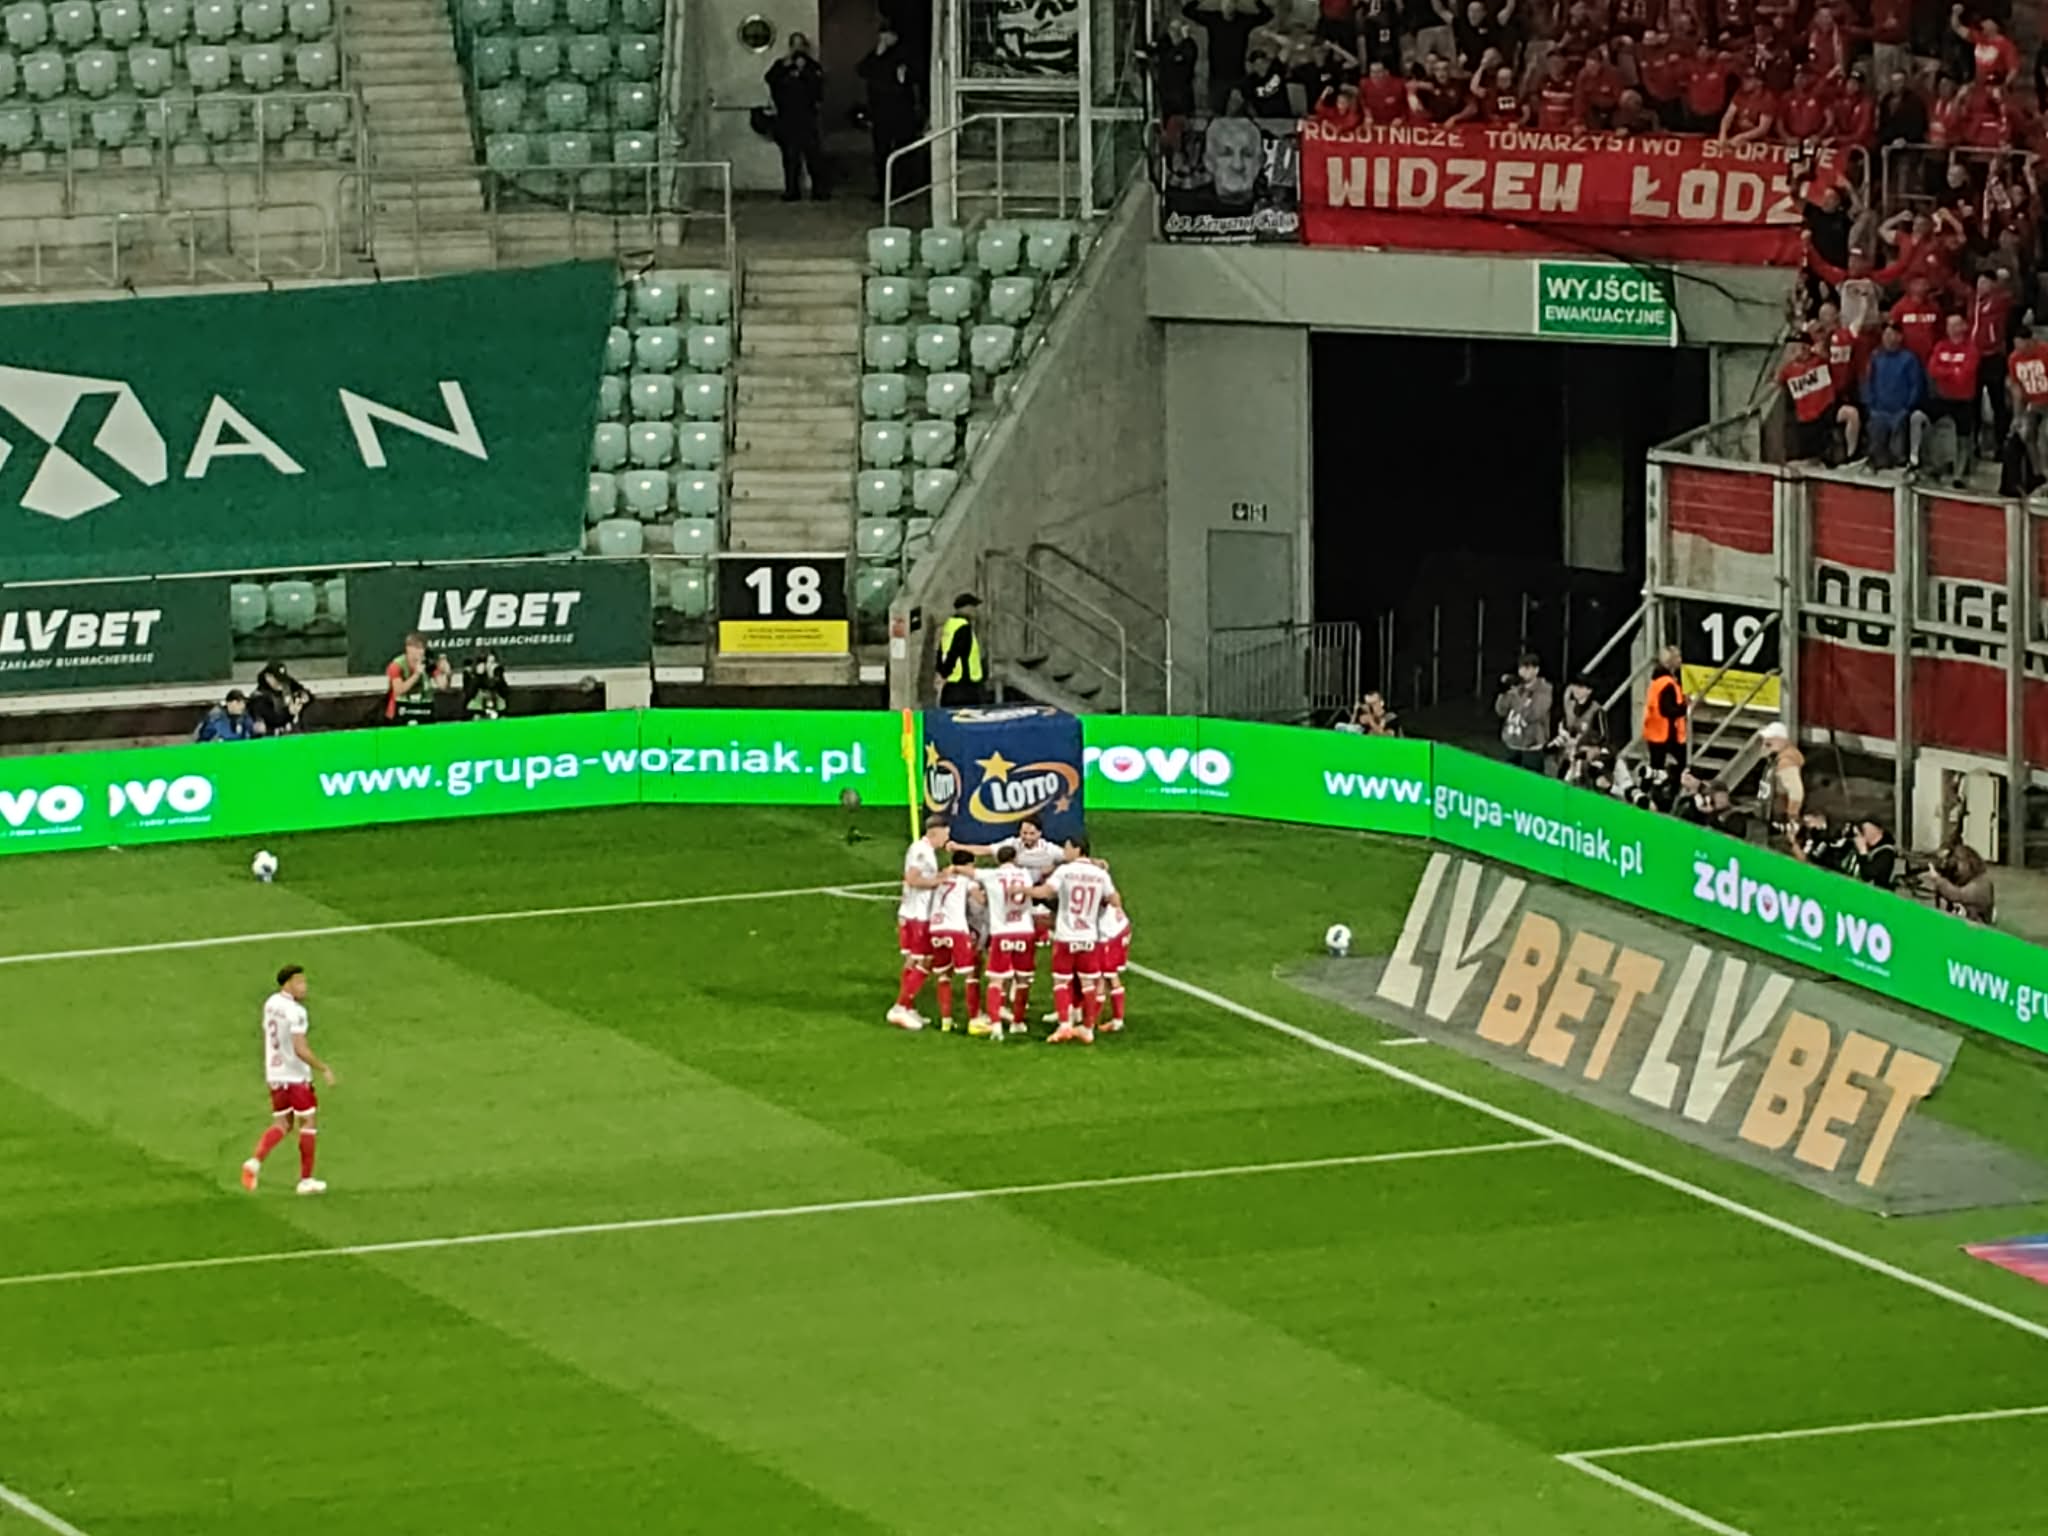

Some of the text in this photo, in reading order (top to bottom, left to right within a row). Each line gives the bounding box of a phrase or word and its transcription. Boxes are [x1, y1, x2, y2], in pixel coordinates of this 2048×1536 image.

[1702, 138, 1838, 169] SORTE
[1327, 155, 1584, 212] WIDZEW
[1546, 274, 1666, 303] WYJŚCIE
[1545, 305, 1666, 325] EWAKUACYJNE
[745, 566, 822, 615] 18
[1701, 611, 1765, 666] 19
[319, 741, 866, 797] www.grupa-wozniak.pl
[1323, 770, 1644, 878] www.grupa-wozniak.pl
[1070, 885, 1097, 917] 91
